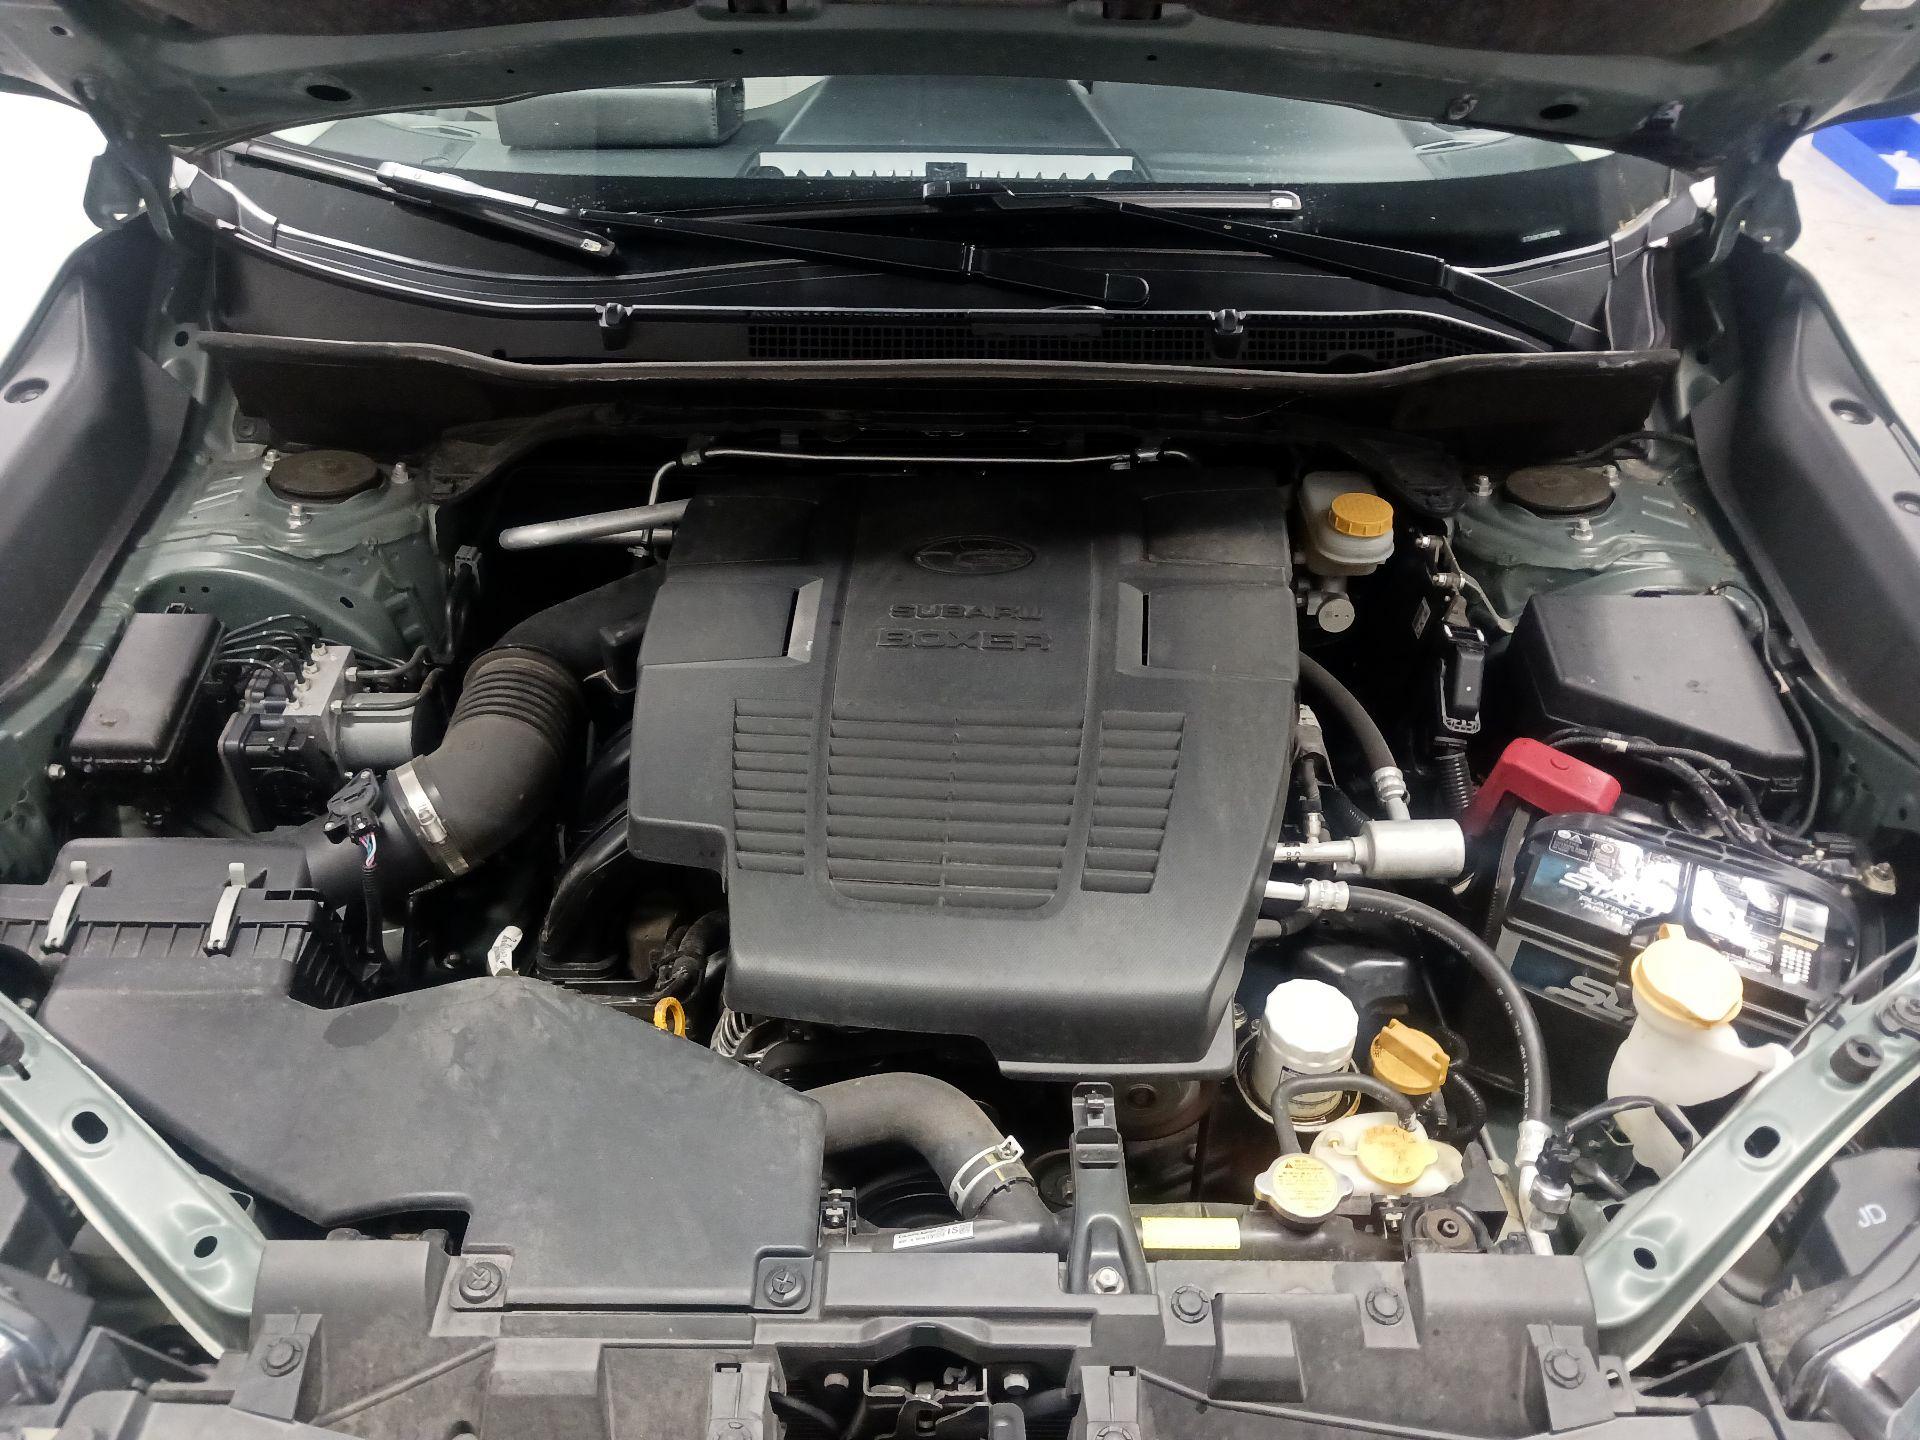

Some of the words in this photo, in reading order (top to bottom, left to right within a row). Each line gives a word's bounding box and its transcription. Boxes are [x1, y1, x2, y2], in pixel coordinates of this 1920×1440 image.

[889, 603, 1042, 621] SUBARU
[876, 628, 1052, 651] BOXER
[1858, 1204, 1887, 1228] JD
